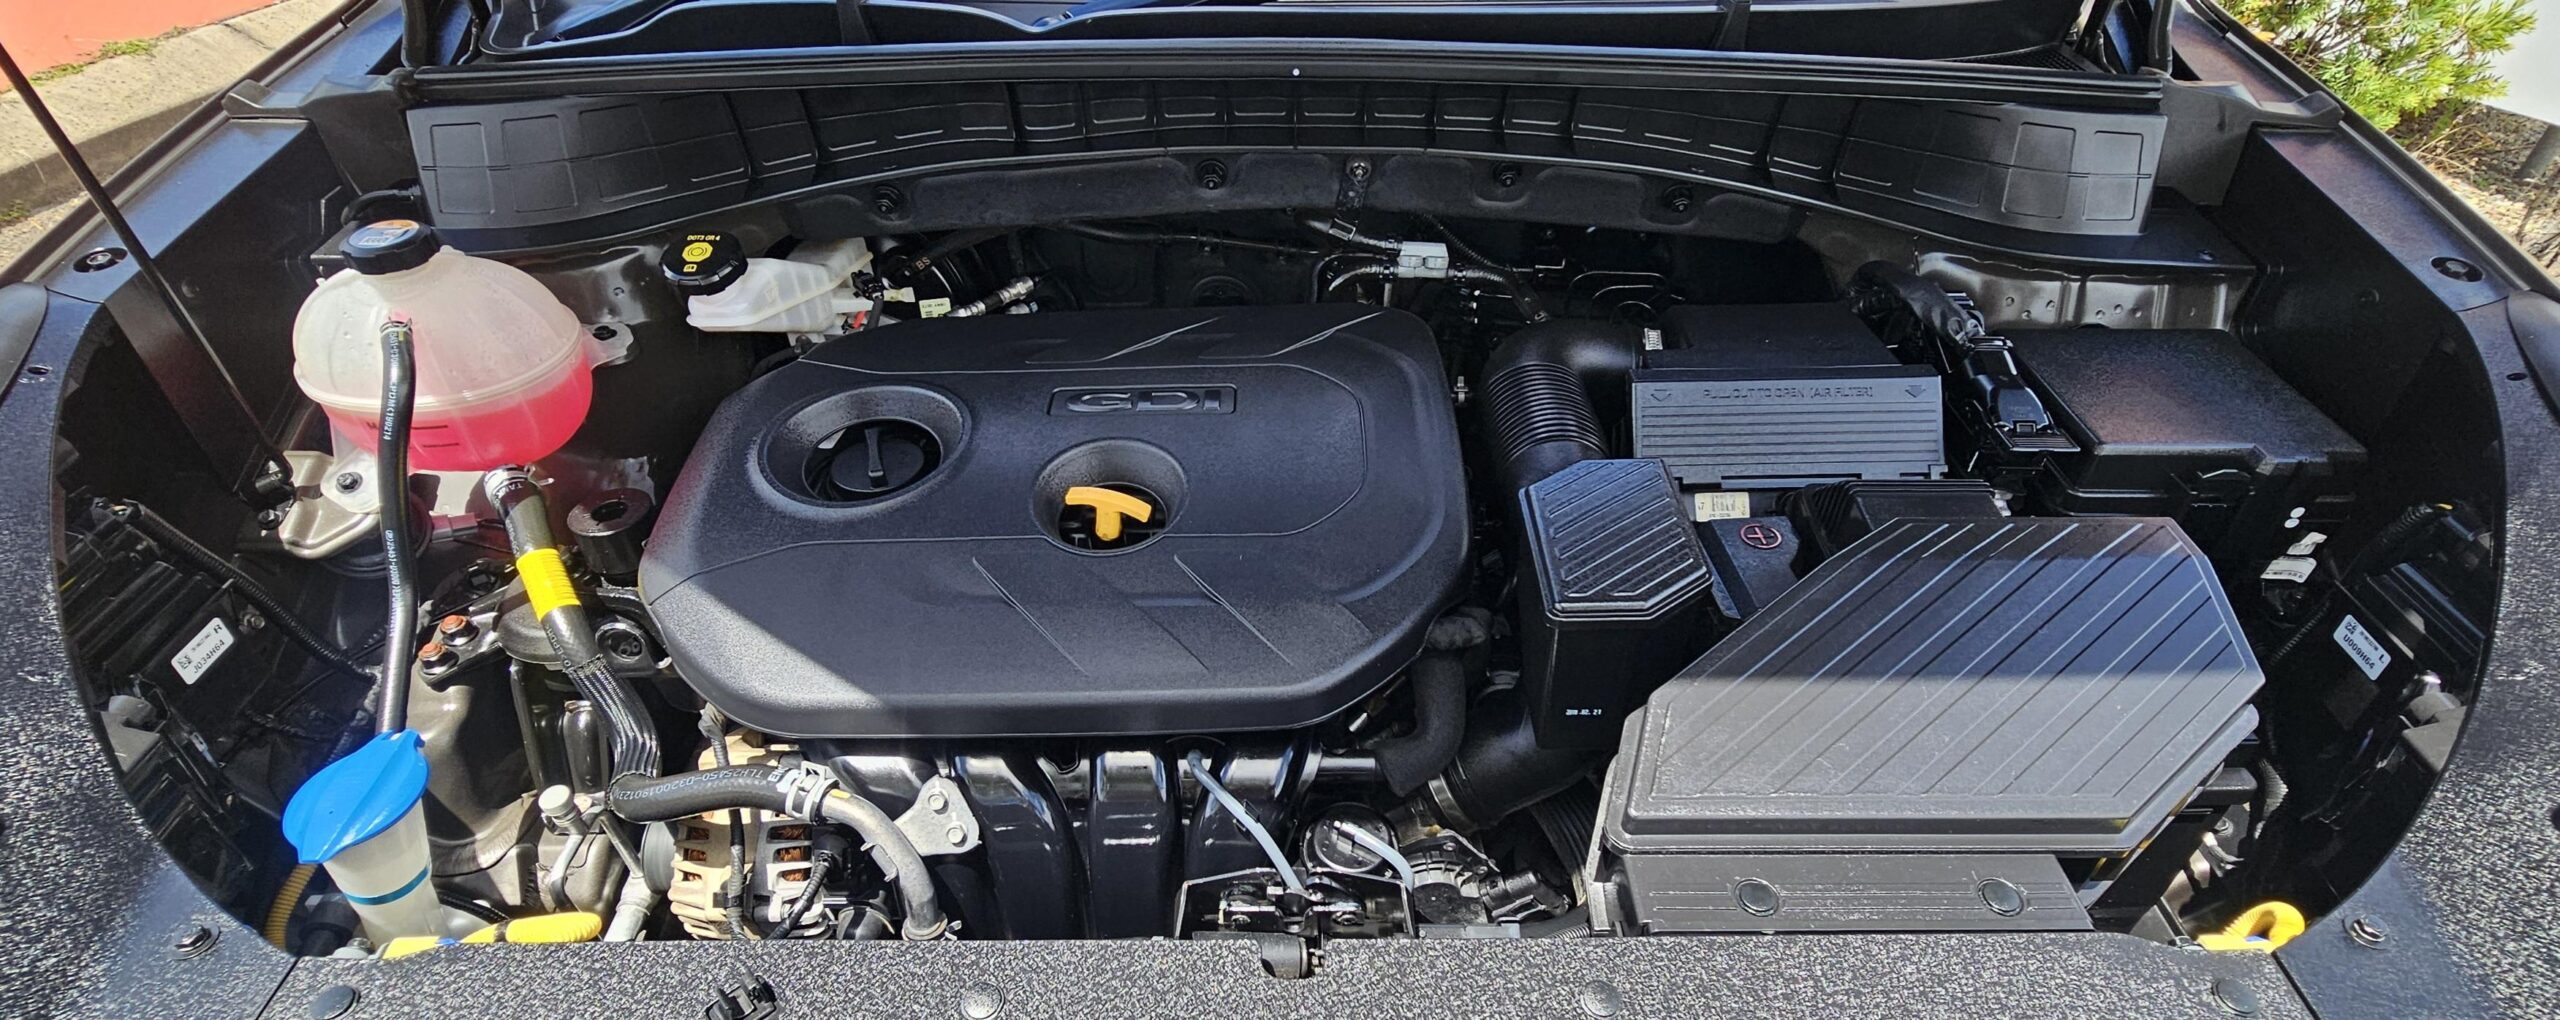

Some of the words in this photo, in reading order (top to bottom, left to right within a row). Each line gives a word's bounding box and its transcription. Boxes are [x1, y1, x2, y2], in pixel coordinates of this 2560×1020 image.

[1703, 388, 1731, 400] PULL
[1732, 388, 1756, 399] OUT
[1757, 387, 1773, 398] TO
[1774, 387, 1804, 398] OPEN
[1065, 389, 1222, 413] GDI
[213, 624, 223, 634] R
[193, 639, 225, 674] J034H64
[2378, 653, 2385, 664] L
